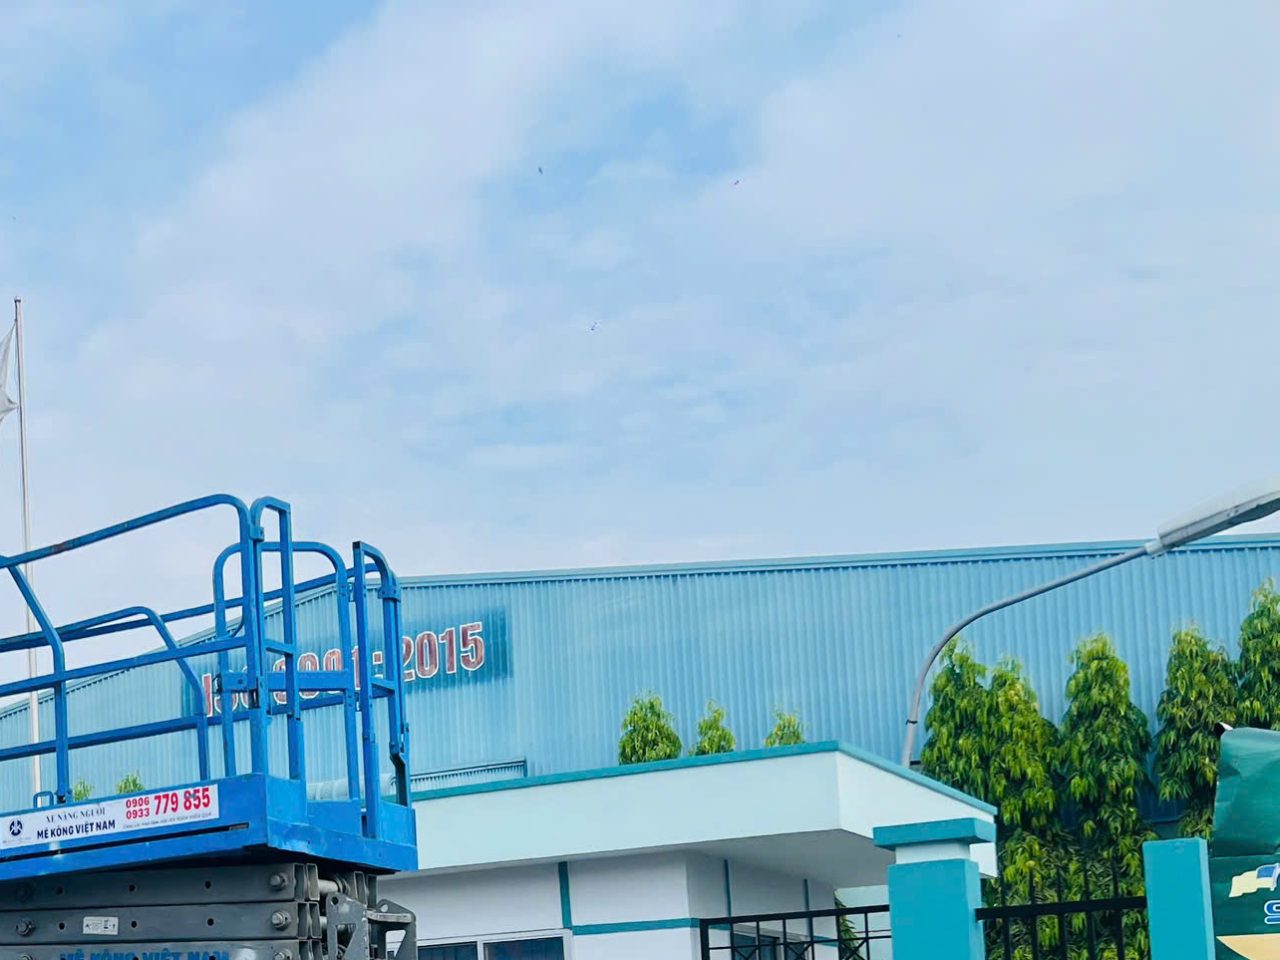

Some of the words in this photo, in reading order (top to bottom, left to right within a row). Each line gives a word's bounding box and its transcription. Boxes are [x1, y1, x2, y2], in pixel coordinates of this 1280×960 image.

[126, 796, 150, 809] 0906
[154, 792, 179, 815] 779
[183, 787, 210, 811] 855
[126, 807, 150, 819] 0933
[96, 819, 116, 831] NAM
